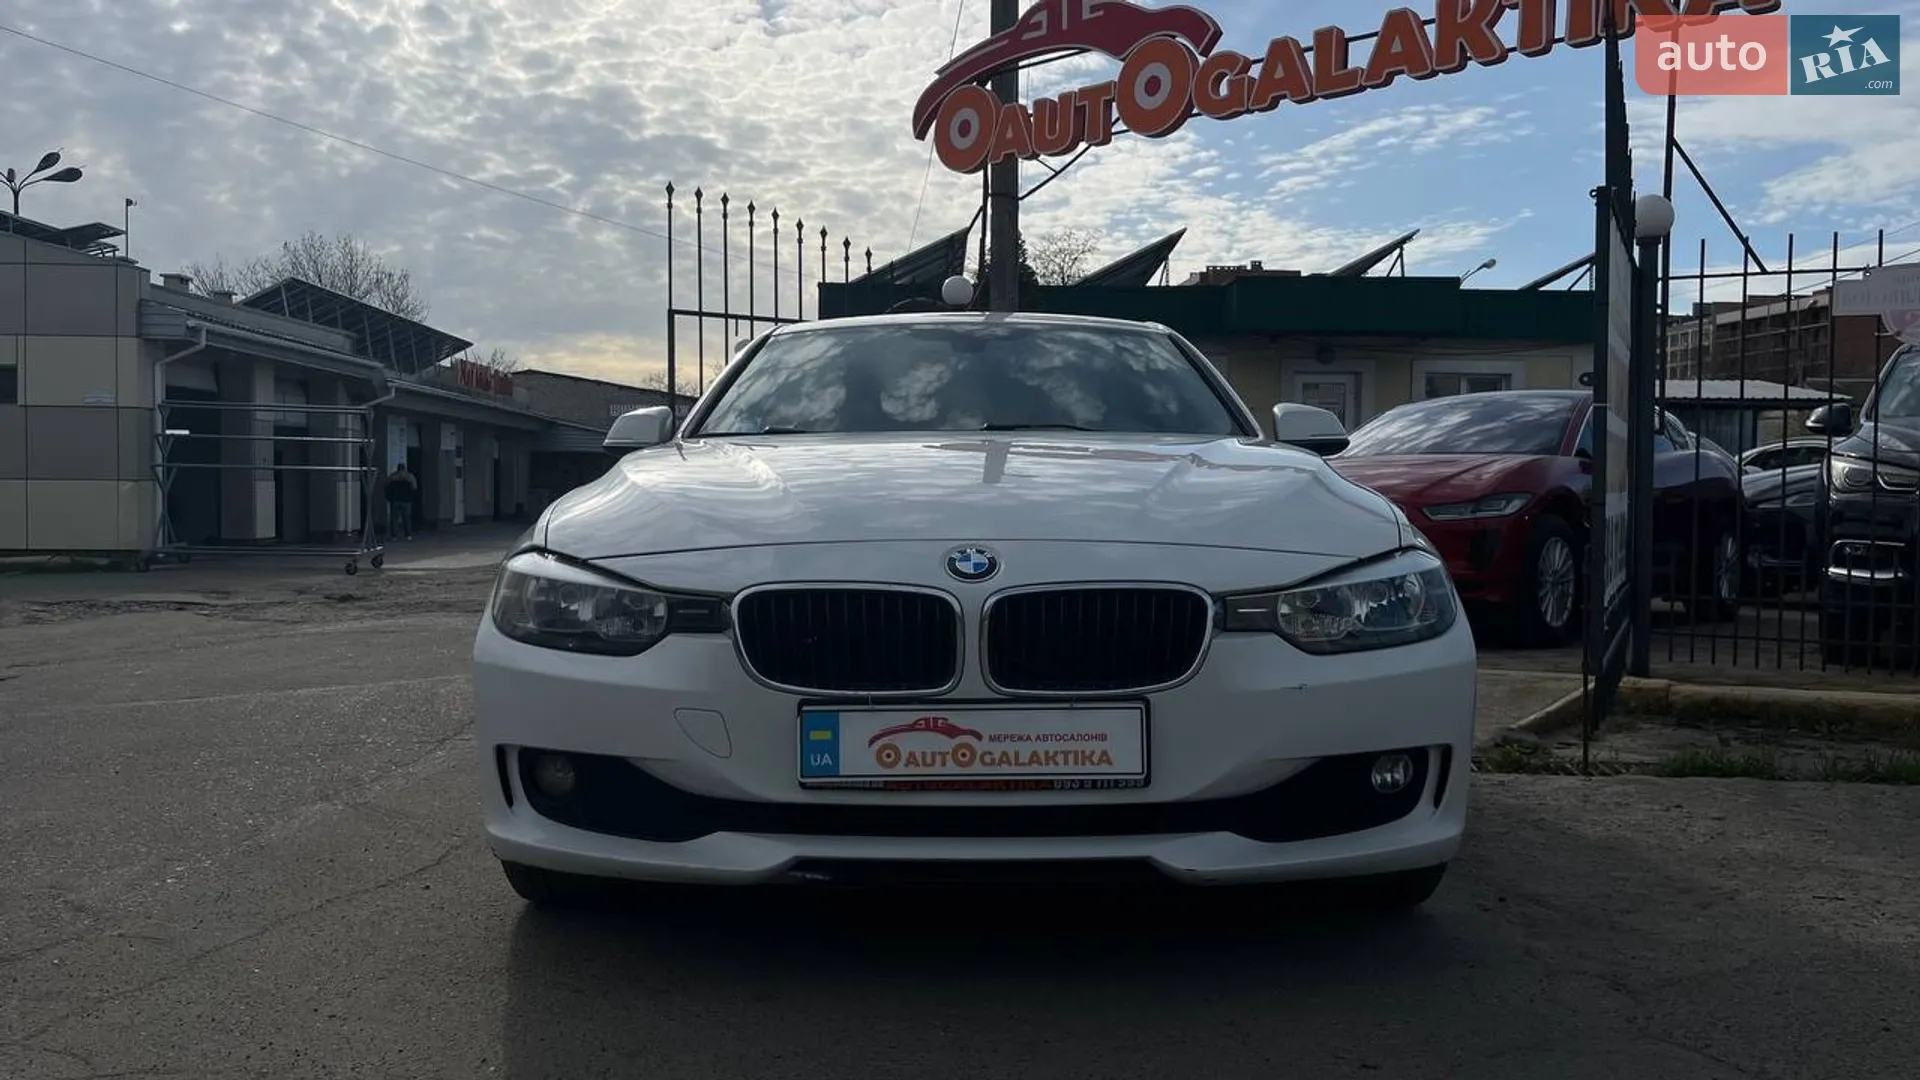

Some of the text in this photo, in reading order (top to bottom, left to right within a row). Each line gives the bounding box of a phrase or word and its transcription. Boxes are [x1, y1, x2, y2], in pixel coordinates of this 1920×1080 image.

[988, 733, 1108, 743] МЕРЕЖА АВТОСАЛОНІВ
[810, 754, 833, 767] UA
